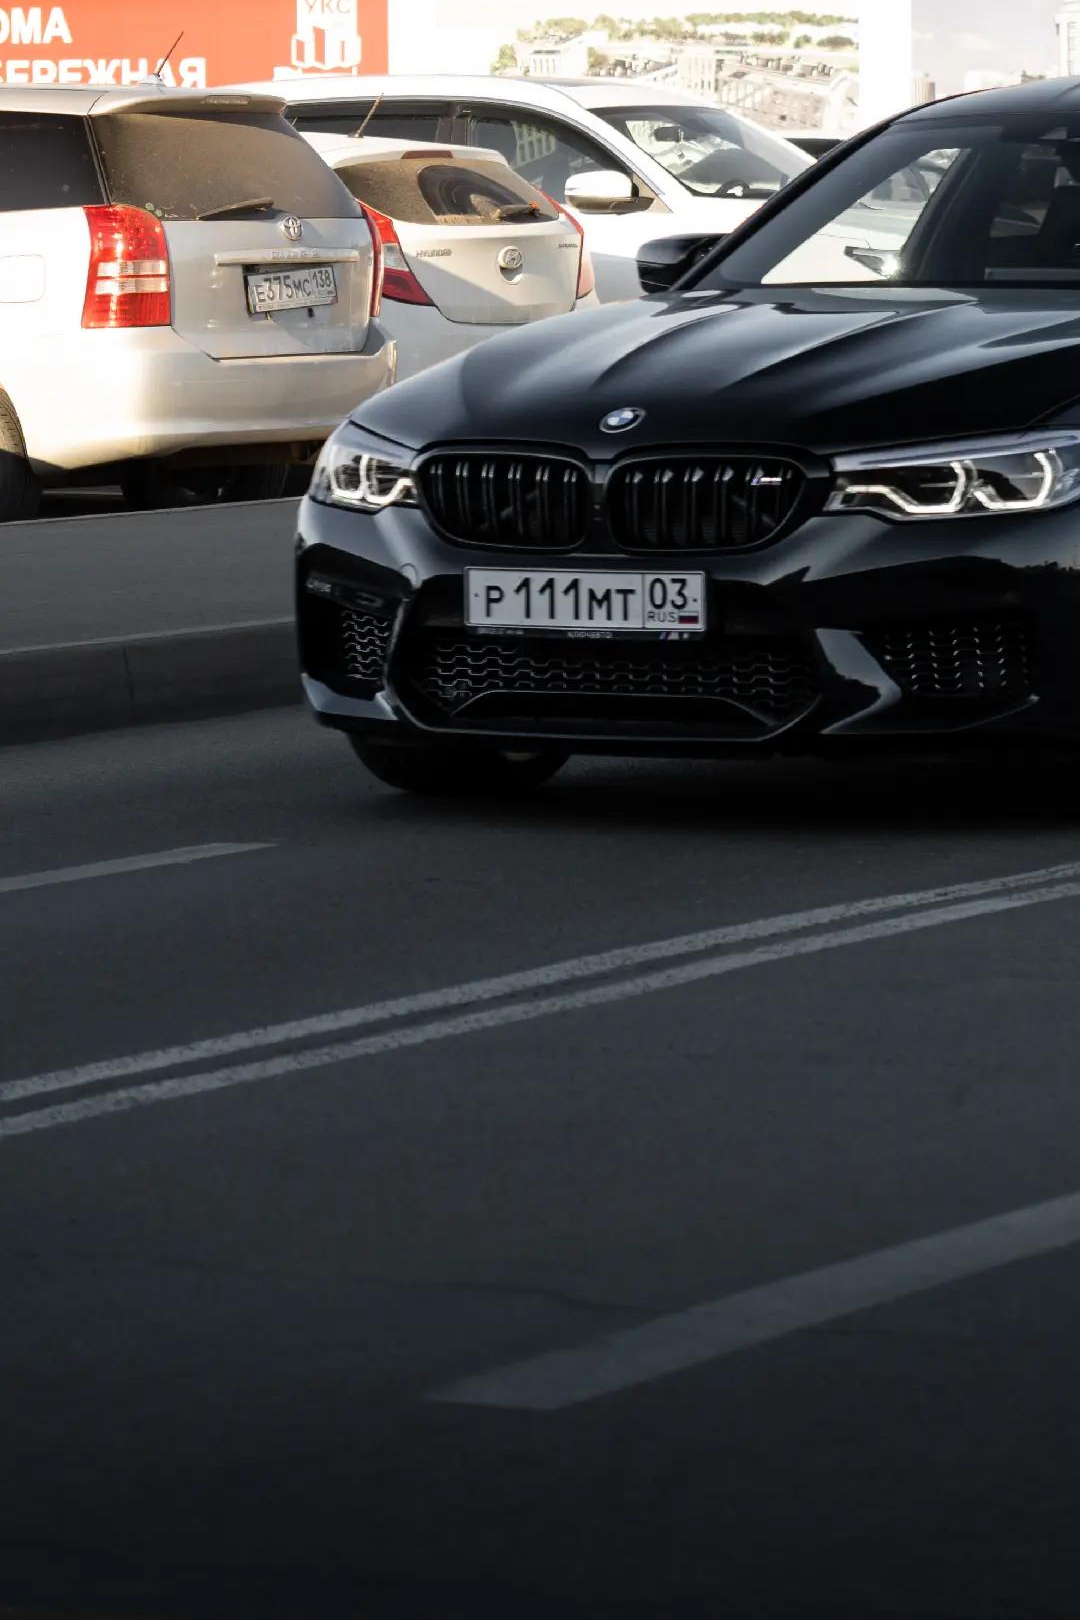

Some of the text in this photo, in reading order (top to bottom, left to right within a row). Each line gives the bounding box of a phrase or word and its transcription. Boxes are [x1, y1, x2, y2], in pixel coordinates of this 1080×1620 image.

[312, 270, 332, 289] 138
[648, 578, 688, 611] 03
[647, 611, 678, 623] RUS
